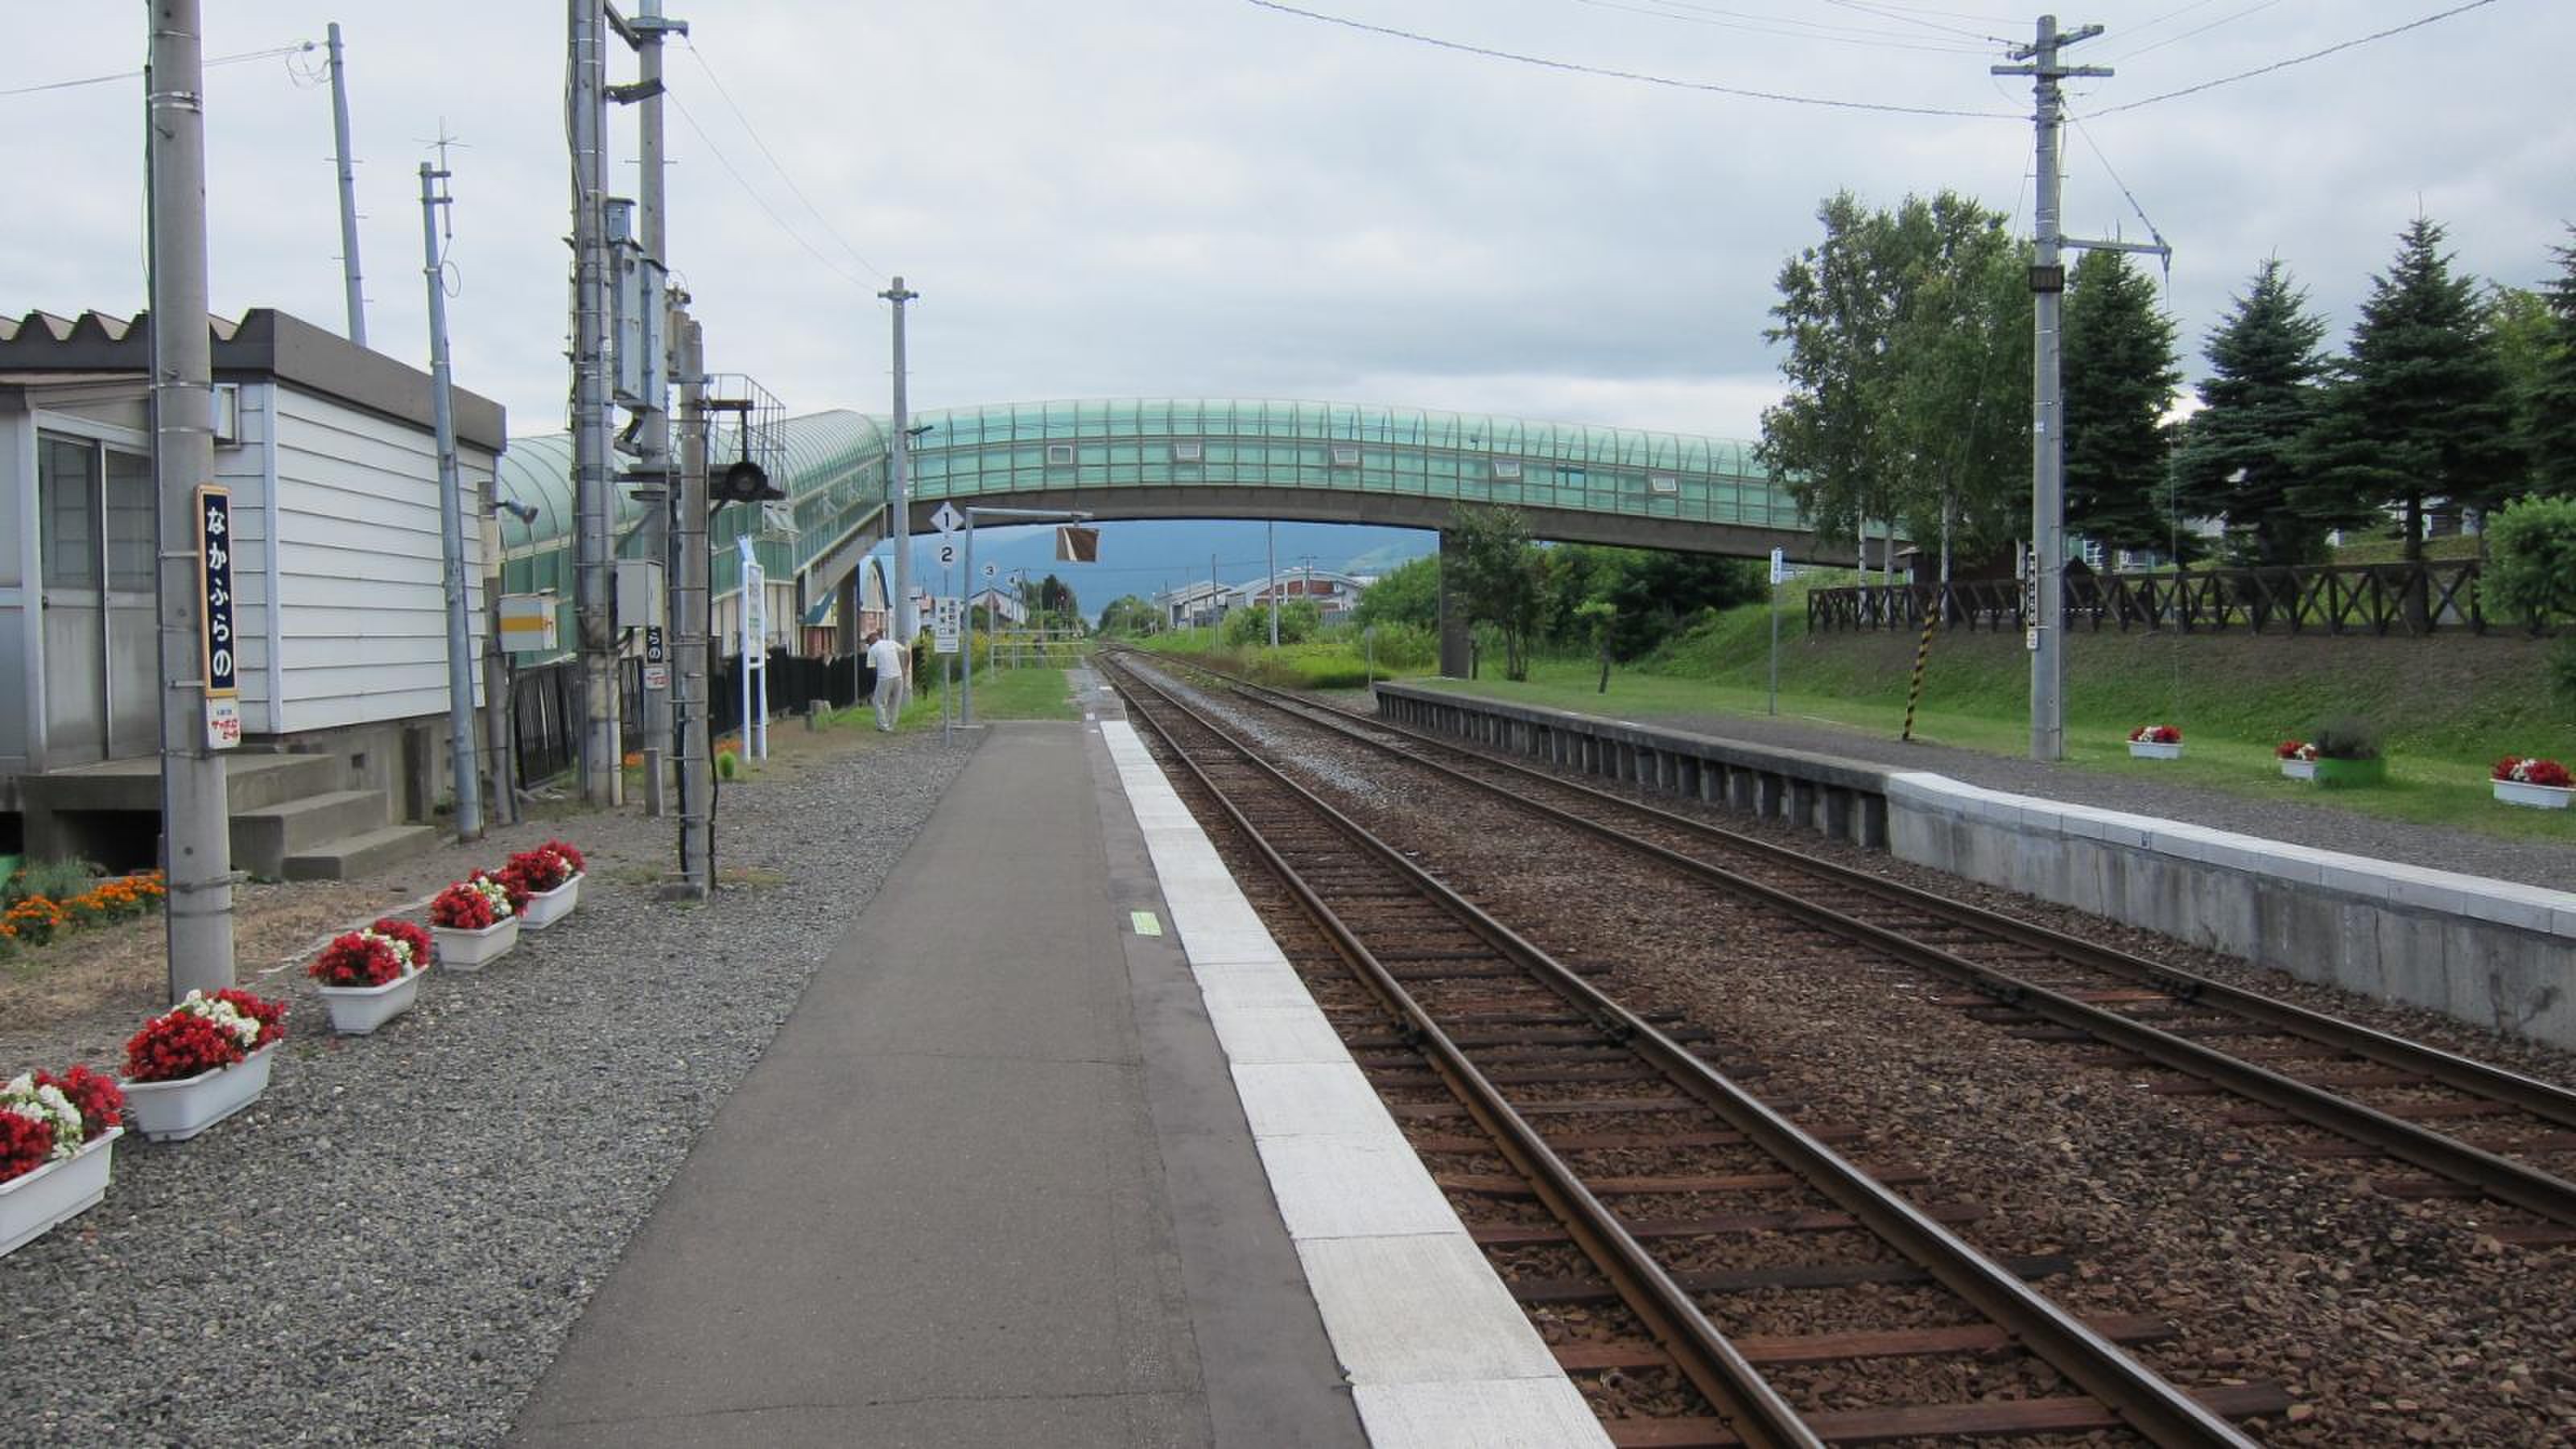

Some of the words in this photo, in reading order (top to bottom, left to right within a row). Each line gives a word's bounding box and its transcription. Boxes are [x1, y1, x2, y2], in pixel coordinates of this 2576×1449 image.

[944, 512, 950, 528] 1
[941, 547, 953, 562] 2
[985, 566, 994, 576] 3
[207, 506, 232, 677] なかふらの
